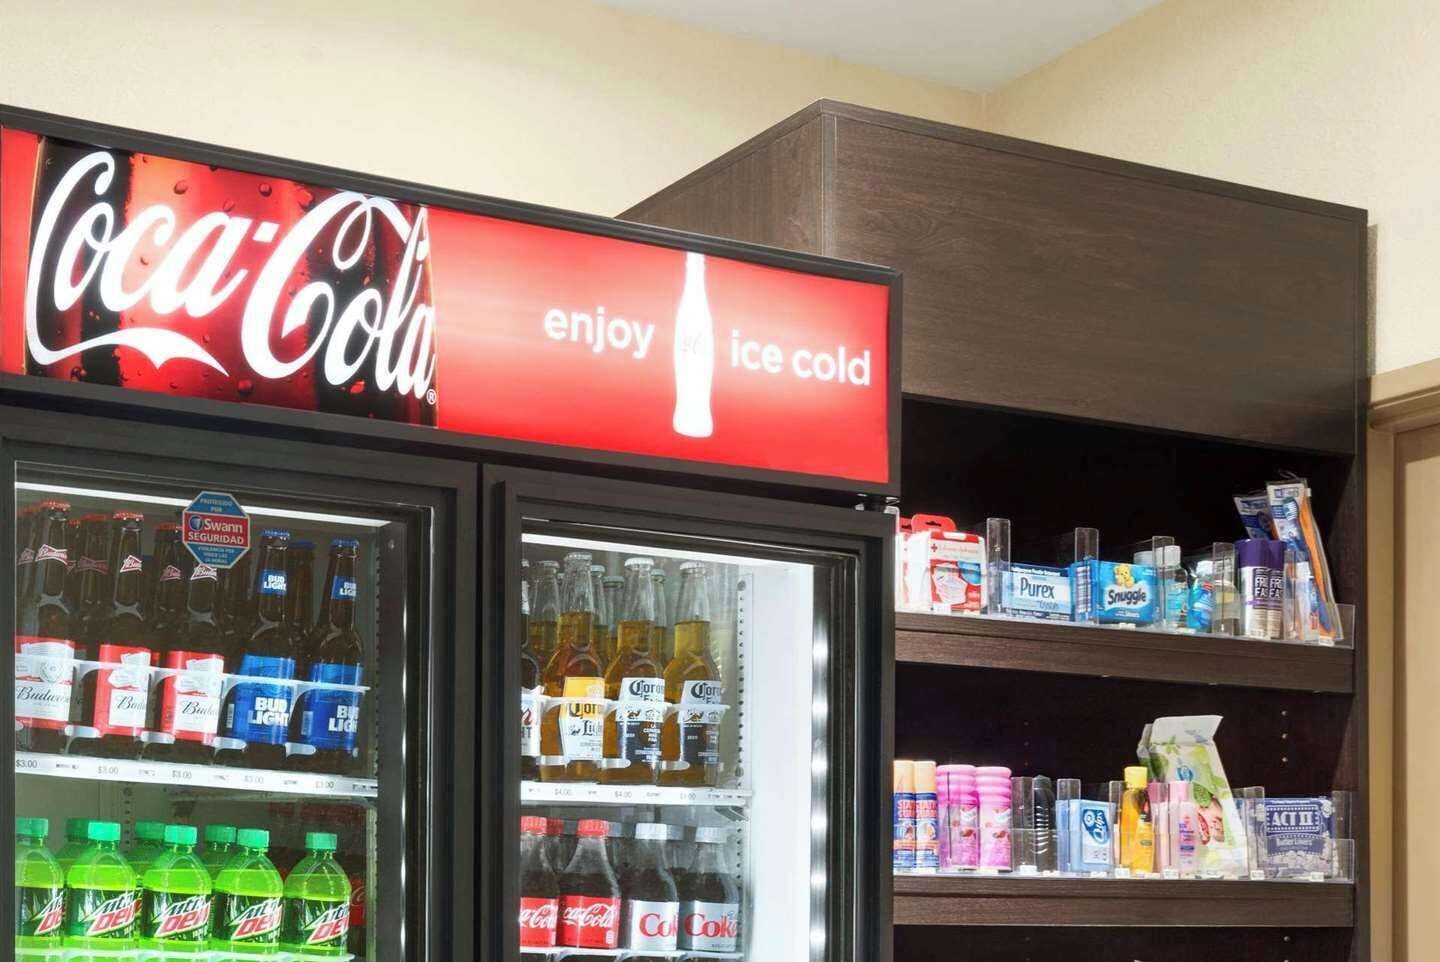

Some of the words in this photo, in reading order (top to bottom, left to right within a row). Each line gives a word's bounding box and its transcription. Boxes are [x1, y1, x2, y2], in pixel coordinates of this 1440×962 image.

[25, 151, 436, 399] Coca-Cola
[543, 306, 654, 359] enjoy
[730, 329, 784, 374] ice
[791, 346, 871, 386] cold
[204, 518, 243, 533] Swann
[188, 532, 244, 545] SEGURIDAD
[1020, 577, 1055, 599] Purex
[1107, 588, 1146, 606] Snuggle
[255, 697, 287, 712] BUD
[16, 759, 38, 768] $3.00
[1272, 812, 1297, 827] ACT
[1300, 811, 1313, 825] II
